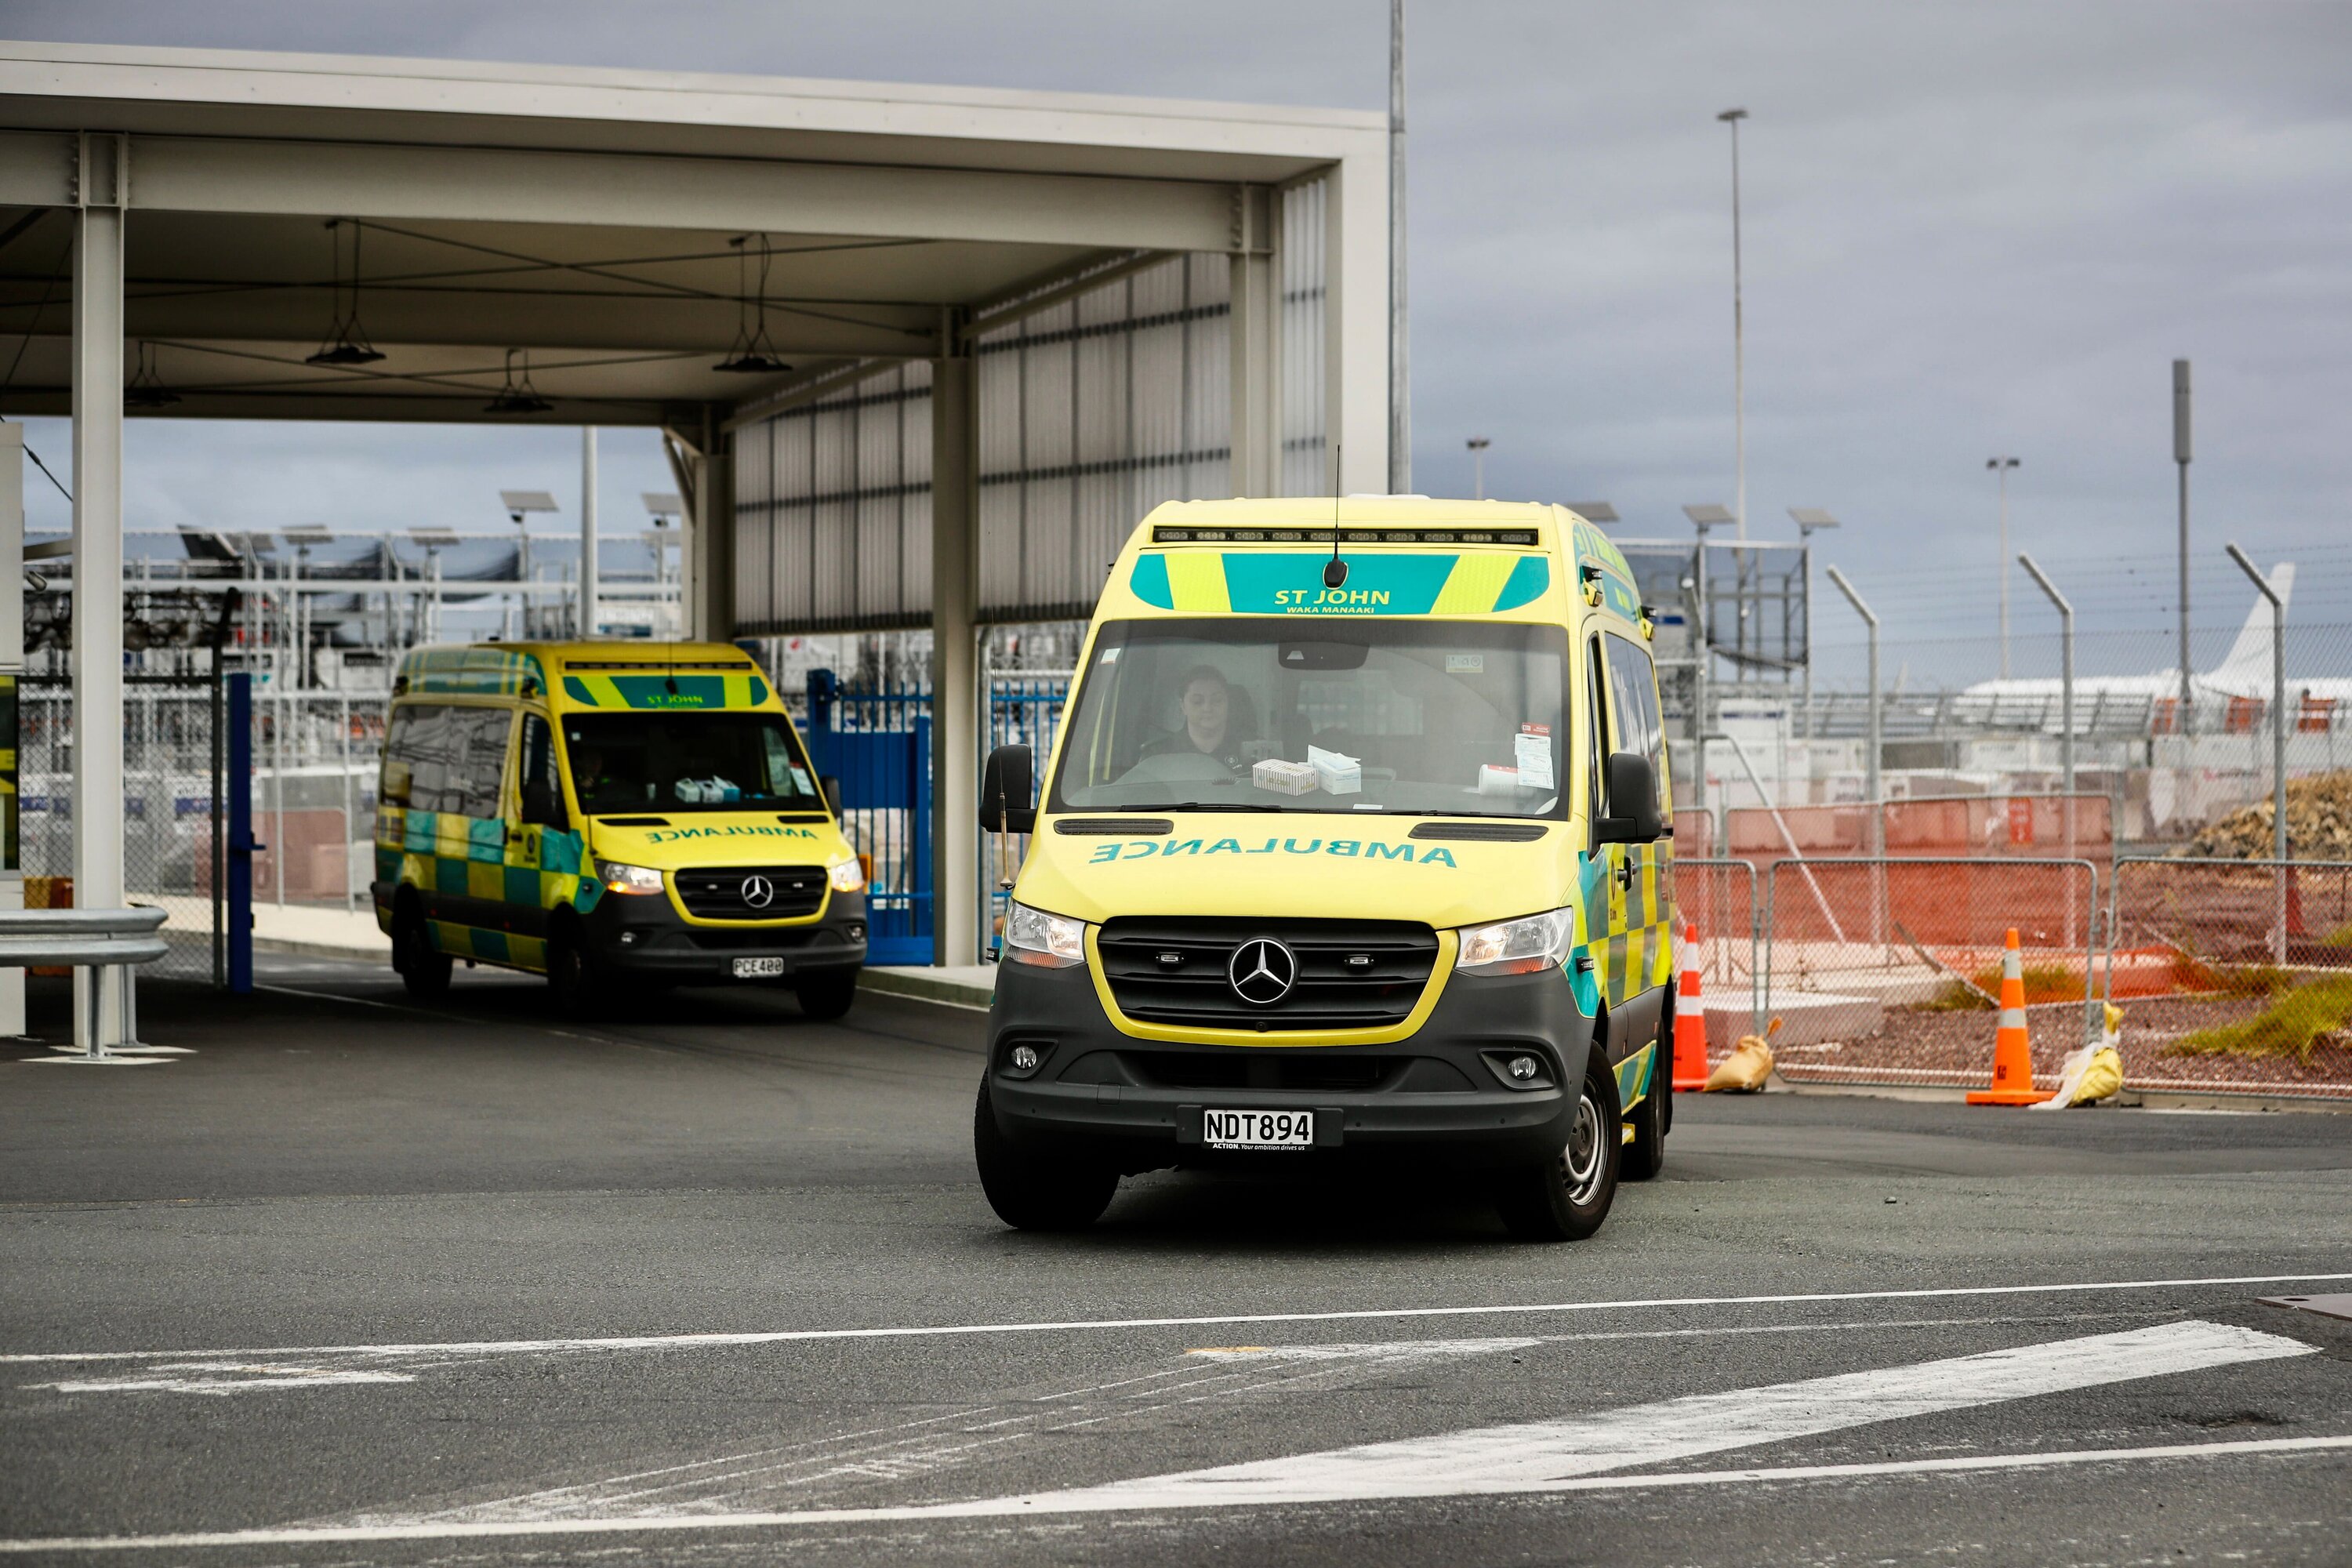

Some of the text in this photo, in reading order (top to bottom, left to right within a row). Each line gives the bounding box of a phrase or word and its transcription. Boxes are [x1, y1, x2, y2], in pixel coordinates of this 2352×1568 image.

[1275, 590, 1390, 605] ST JOHN
[647, 695, 662, 704] ST
[1207, 1113, 1309, 1141] NDT894
